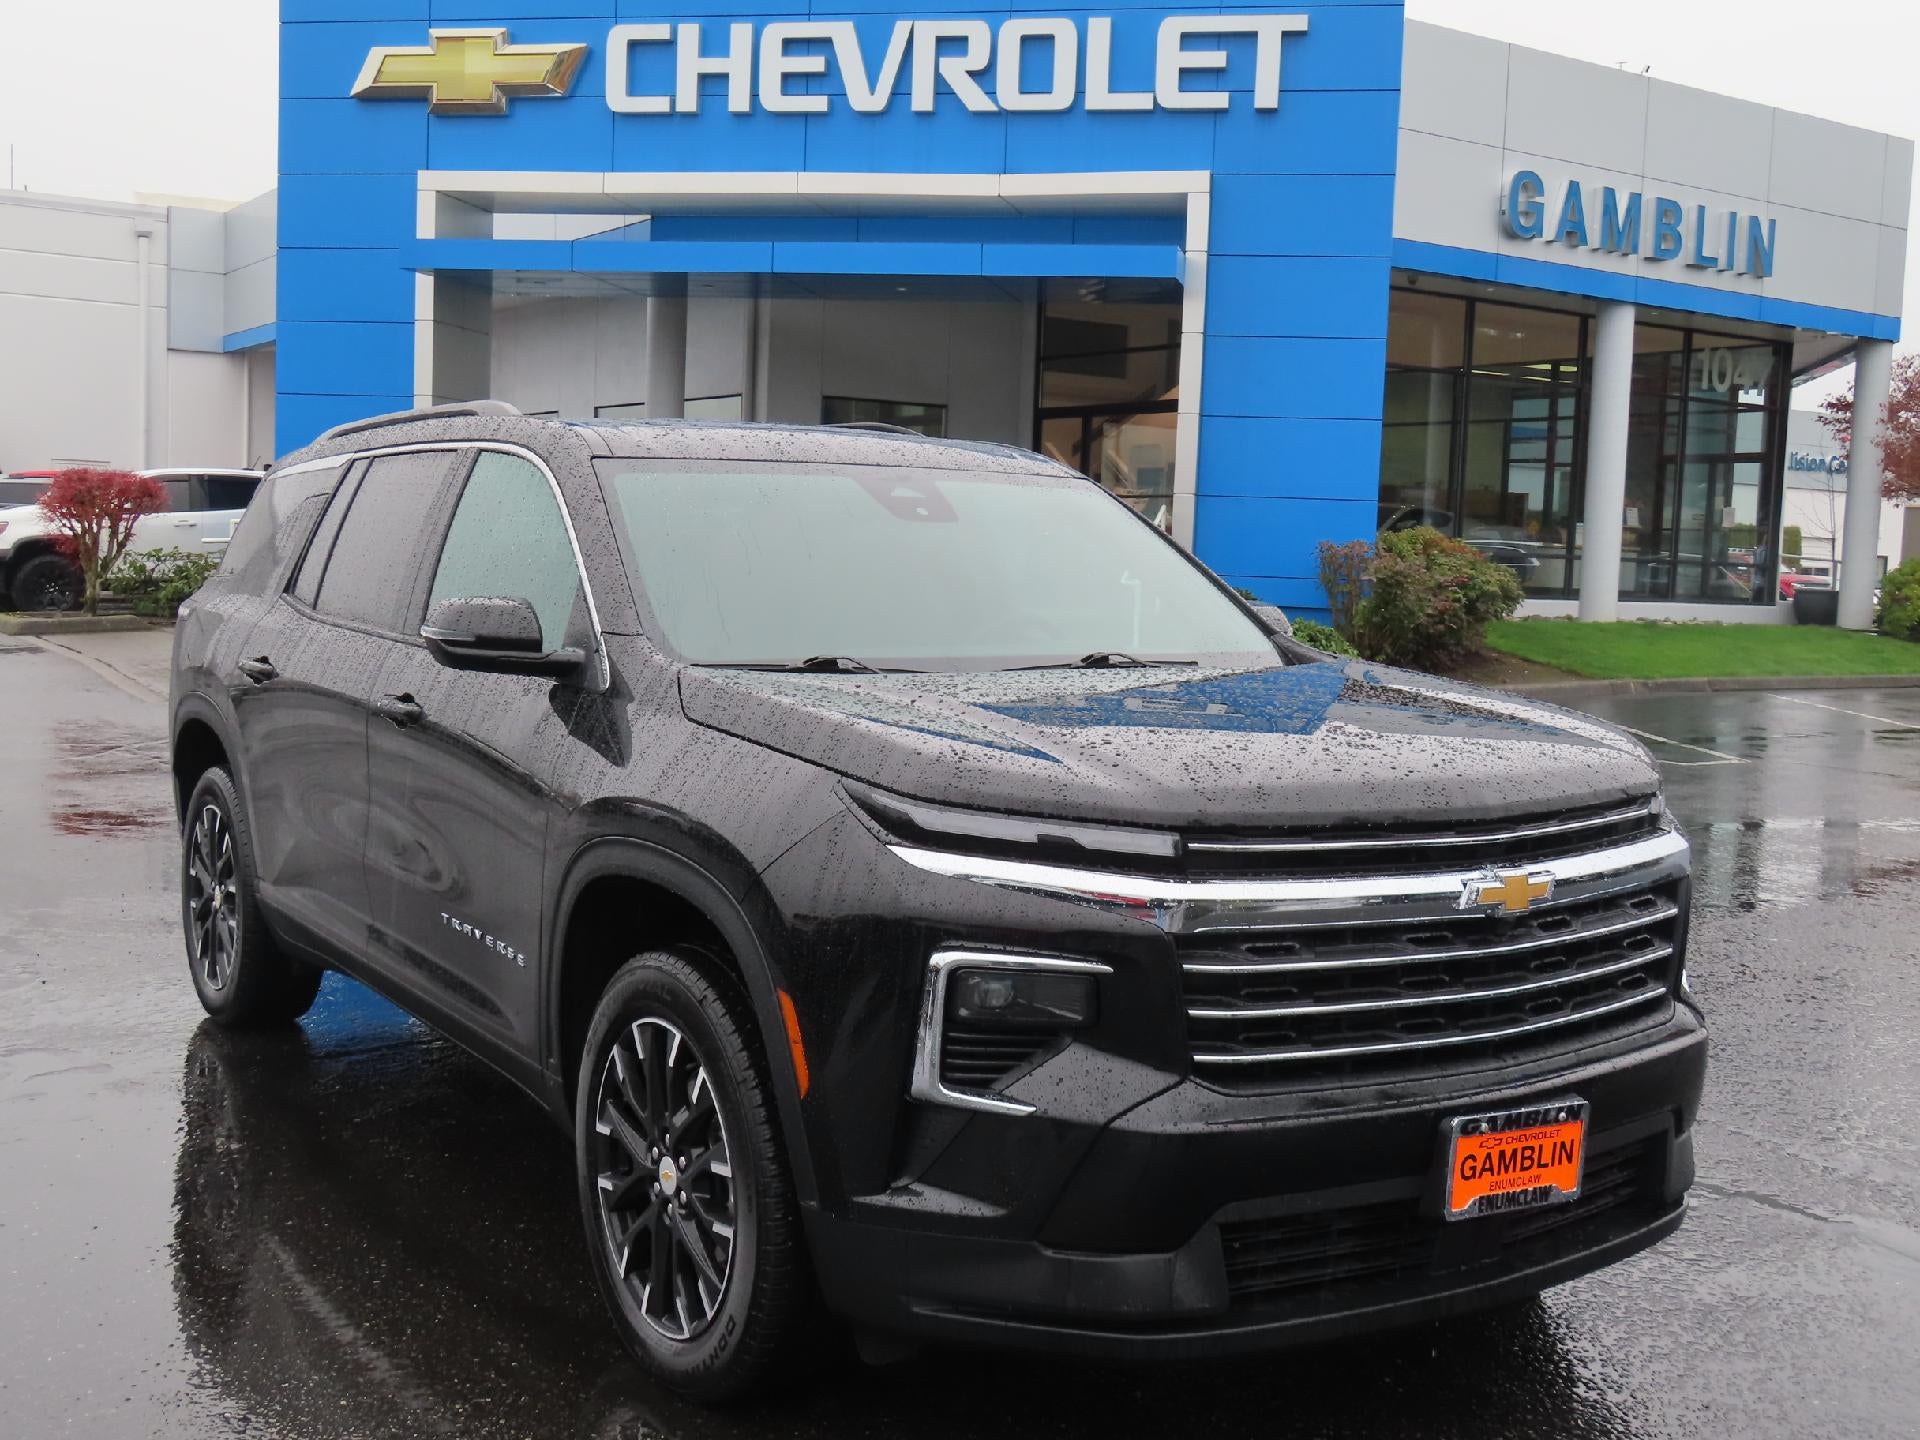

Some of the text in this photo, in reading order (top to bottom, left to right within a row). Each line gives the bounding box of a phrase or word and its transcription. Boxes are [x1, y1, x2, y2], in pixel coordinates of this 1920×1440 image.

[605, 14, 1309, 114] CHEVROLET
[1506, 169, 1777, 278] GAMBLIN
[1696, 347, 1776, 396] 1047
[1788, 451, 1826, 472] lision
[440, 911, 527, 968] TRAVERSE
[1505, 1129, 1562, 1145] CHEVROLET
[1460, 1138, 1575, 1181] GAMBLIN
[1478, 1185, 1554, 1214] ENUMCLAW
[1488, 1174, 1542, 1192] ENUMCLAW
